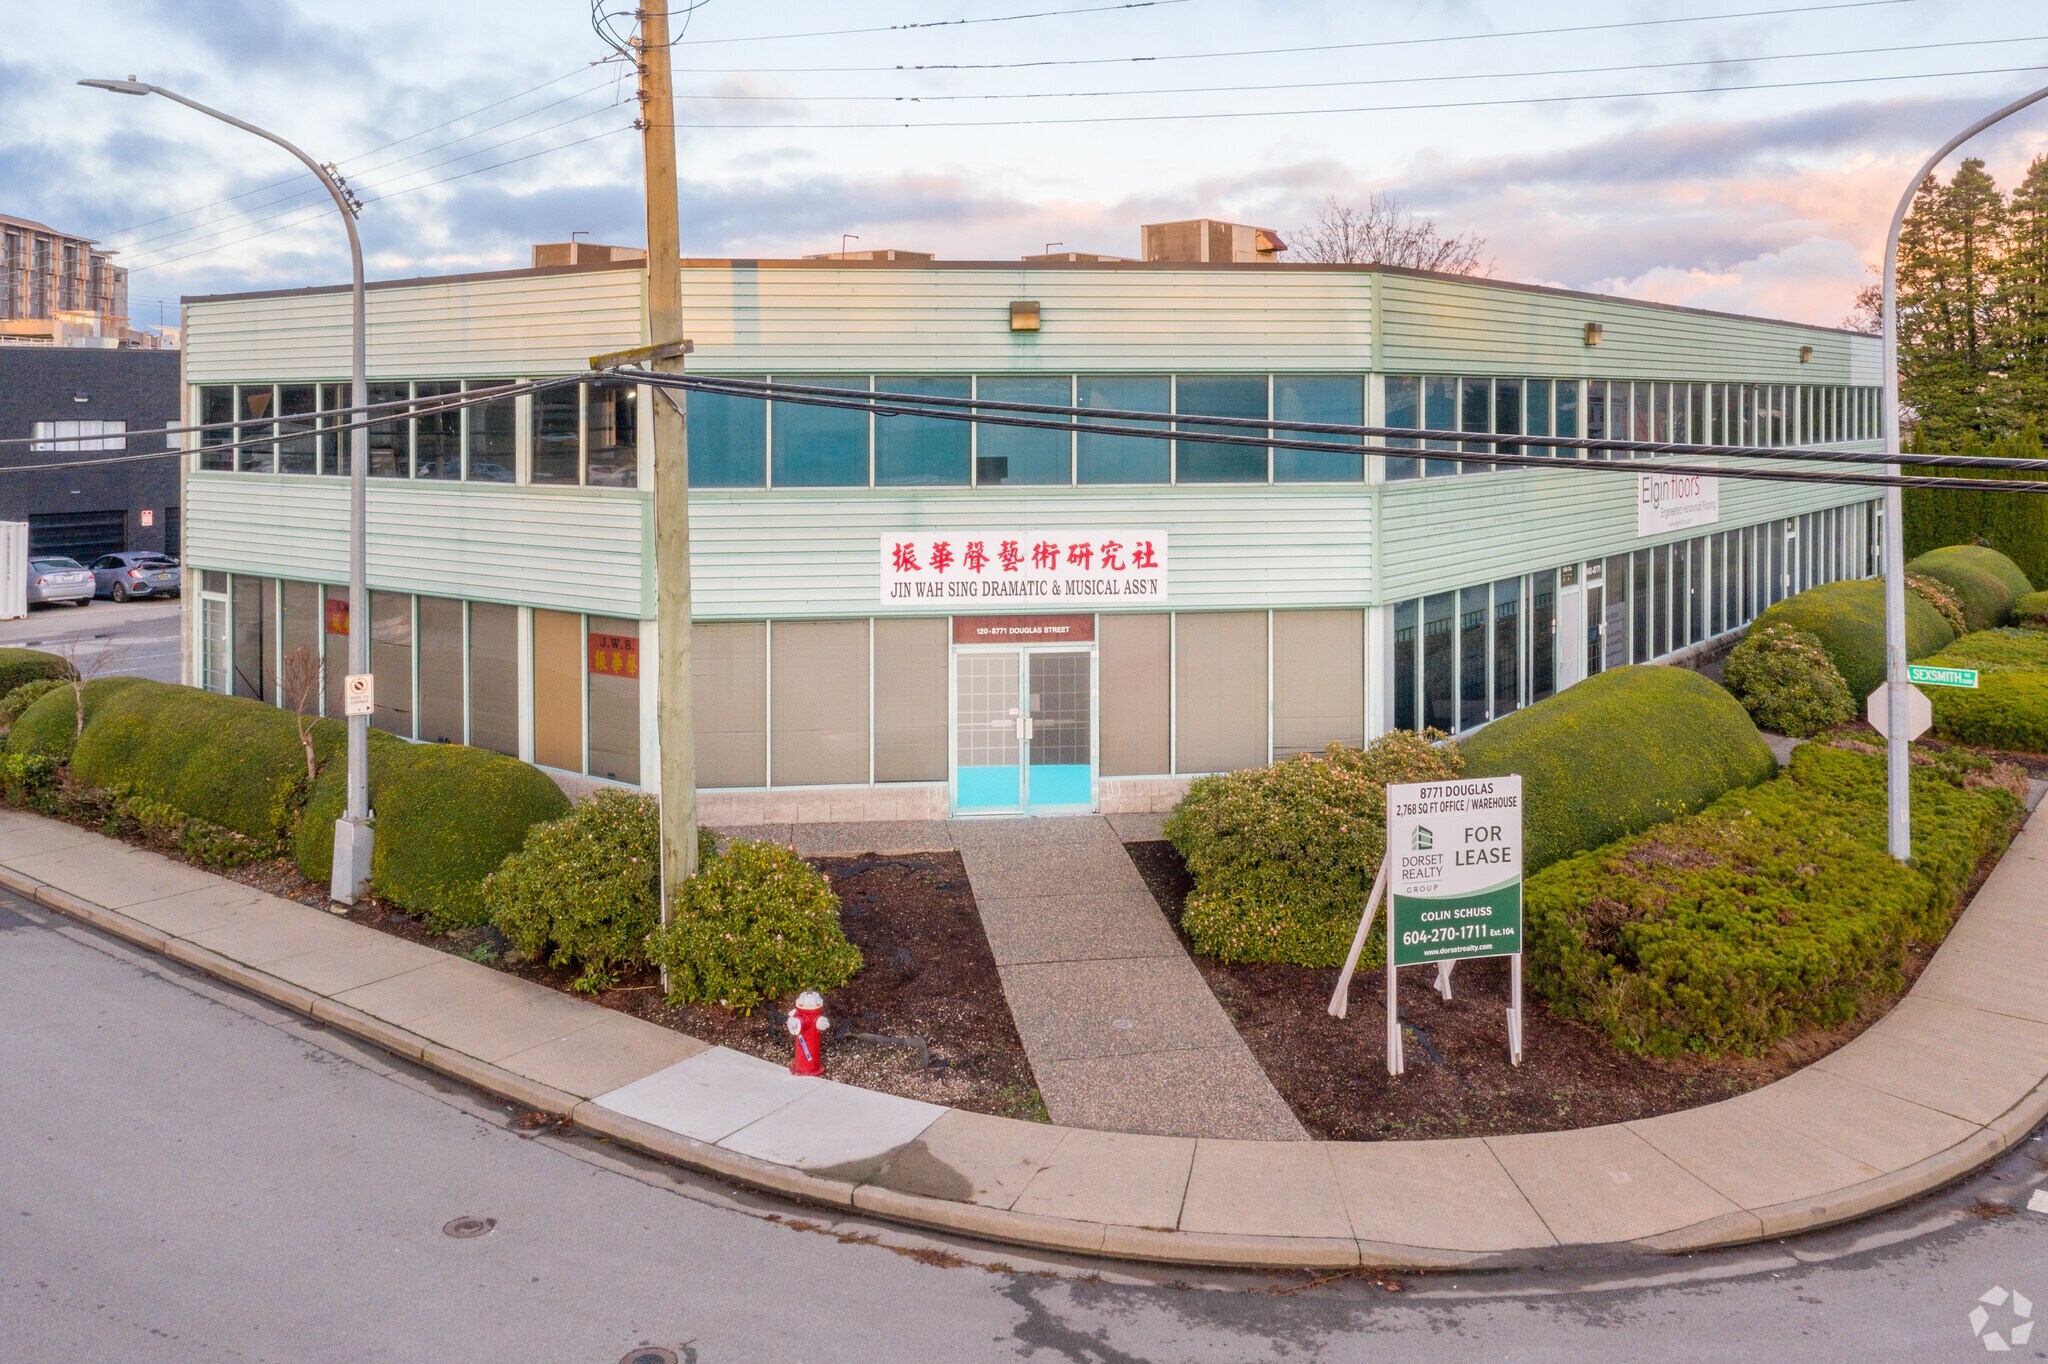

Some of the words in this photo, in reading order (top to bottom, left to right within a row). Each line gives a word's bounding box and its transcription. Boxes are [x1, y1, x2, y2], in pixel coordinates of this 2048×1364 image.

[1642, 475, 1669, 509] Elgin
[1671, 473, 1700, 499] floors
[891, 540, 1159, 574] 振華聲藝術研究社
[891, 582, 912, 598] JIN
[915, 582, 944, 598] WAH
[948, 581, 978, 597] SING
[982, 580, 1048, 597] DRAMATIC
[1052, 581, 1061, 596] &
[1065, 579, 1120, 595] MUSICAL
[1123, 579, 1158, 595] ASS'N
[1043, 626, 1070, 634] STREET
[600, 637, 634, 651] J.W.S.
[1912, 668, 1961, 683] SEXSMITH
[1420, 786, 1443, 799] 8771
[1445, 783, 1494, 797] DOUGLAS
[1396, 803, 1417, 817] 2,768
[1418, 803, 1428, 814] SQ
[1430, 802, 1438, 813] FT
[1439, 800, 1464, 813] OFFICE
[1472, 796, 1517, 810] WAREHOUSE
[1464, 825, 1502, 844] FOR
[1402, 853, 1443, 868] DORSET
[1455, 847, 1511, 867] LEASE
[1402, 866, 1443, 880] REALTY
[1406, 884, 1439, 894] GROUP
[1421, 910, 1451, 922] COLIN
[1453, 906, 1492, 919] SCHUSS
[1403, 924, 1487, 945] 604-270-1711
[1424, 943, 1492, 956] www.dorsetrealty.com
